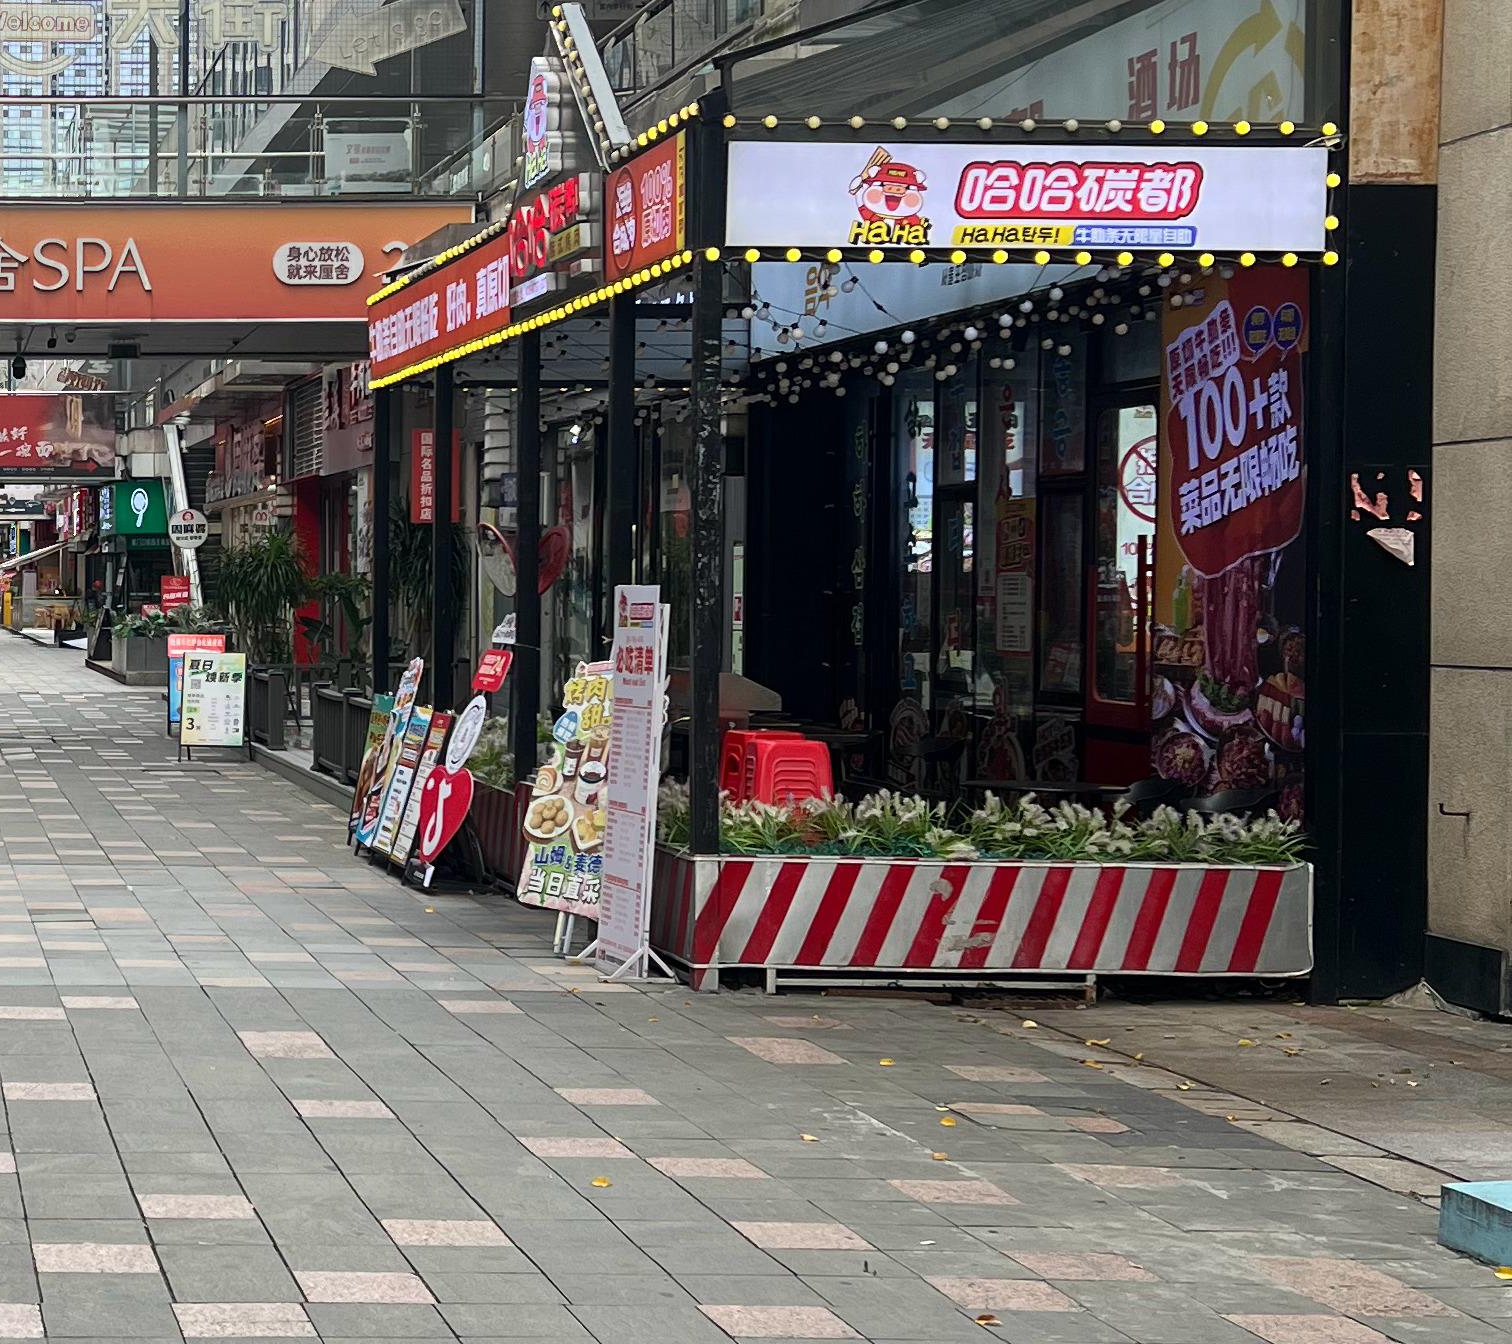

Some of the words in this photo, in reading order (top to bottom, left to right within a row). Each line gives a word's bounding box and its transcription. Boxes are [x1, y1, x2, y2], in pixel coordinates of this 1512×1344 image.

[961, 167, 1196, 213] 哈哈碳都
[286, 244, 351, 263] 身心放松
[286, 262, 351, 281] 就来厘舍
[420, 432, 433, 520] 国际名品折扣店
[1178, 424, 1302, 536] 菜品无限畅吃
[527, 867, 602, 905] 当日直采
